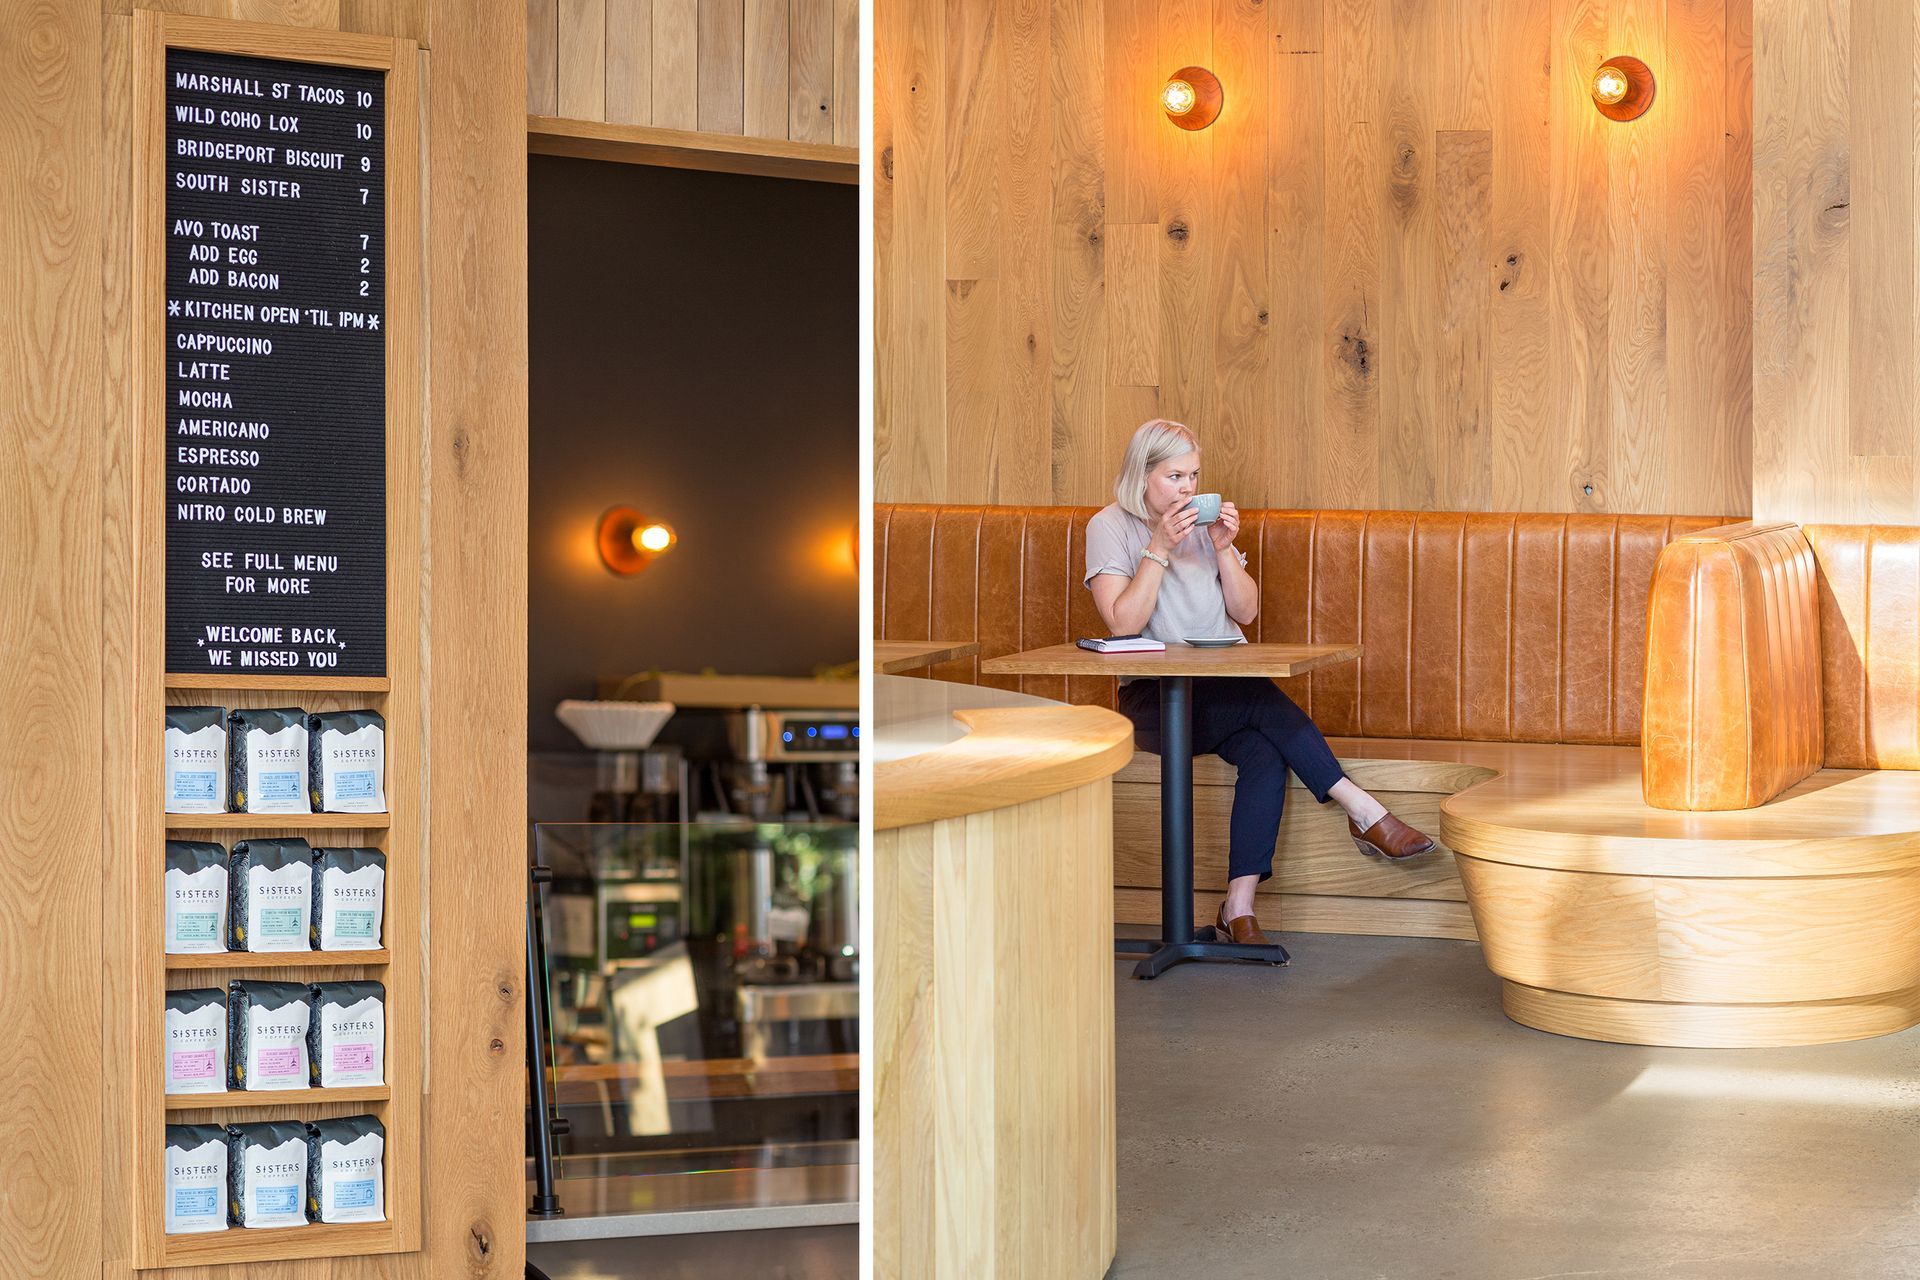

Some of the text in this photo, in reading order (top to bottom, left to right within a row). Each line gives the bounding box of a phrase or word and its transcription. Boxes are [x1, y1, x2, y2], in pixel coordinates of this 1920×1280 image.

[177, 73, 372, 108] MARSHALL ST TACOS 10
[176, 106, 371, 140] WILD COHO LOX 10
[178, 139, 370, 172] BRIDGEPORT BISCUIT 9
[176, 173, 368, 204] SOUTH SISTER 7
[174, 220, 369, 250] AVO TOAST 7
[190, 245, 369, 273] ADD EGG 2
[189, 268, 369, 296] ADD BACON 2
[186, 301, 253, 321] KITCHEN
[261, 307, 299, 324] OPEN
[339, 312, 363, 328] 1PM
[177, 333, 272, 355] CAPPUCCINO
[179, 362, 230, 380] LATTE
[180, 390, 232, 408] MOCHA
[178, 419, 269, 439] AMERICANO
[179, 447, 259, 467] ESPRESSO
[177, 476, 250, 494] CORTADO
[178, 504, 326, 525] NITRO COLD BREW
[202, 552, 337, 572] SEE FULL MENU
[226, 576, 310, 594] FOR MORE
[206, 626, 336, 644] WELCOME BACK
[208, 649, 337, 667] WE MISSED YOU
[173, 749, 218, 758] SISTERS
[258, 749, 301, 758] SISTERS
[333, 749, 376, 758] SISTERS
[176, 890, 220, 898] SISTERS
[259, 886, 303, 895] SISTERS
[334, 888, 376, 897] SISTERS
[172, 1028, 218, 1038] SISTERS
[257, 1025, 301, 1035] SISTERS
[332, 1021, 374, 1031] SISTERS
[174, 1165, 218, 1175] SISTERS
[256, 1163, 300, 1173] SISTERS
[333, 1158, 376, 1168] SISTERS
